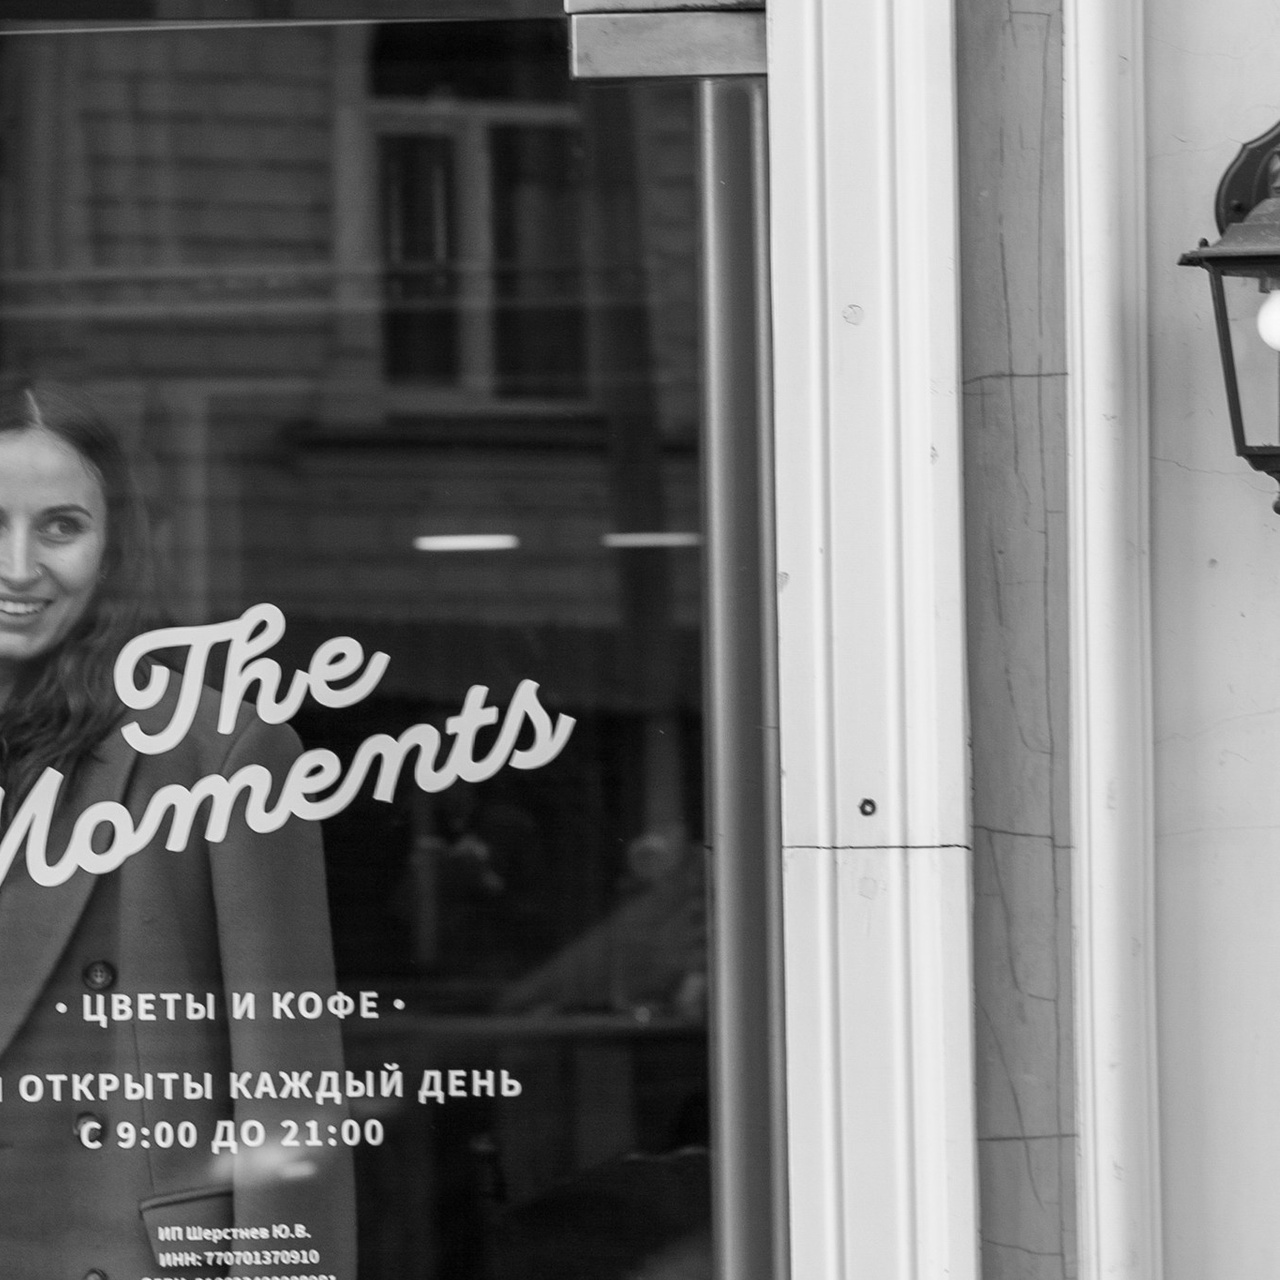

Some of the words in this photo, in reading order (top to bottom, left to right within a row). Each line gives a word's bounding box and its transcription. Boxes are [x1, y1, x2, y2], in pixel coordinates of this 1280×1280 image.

[114, 603, 391, 754] The
[82, 993, 215, 1028] ЦВЕТЫ
[232, 992, 256, 1020] И
[272, 991, 380, 1020] КОФЕ
[18, 1073, 213, 1102] ОТКРЫТЫ
[230, 1063, 403, 1106] КАЖДЫЙ
[418, 1070, 522, 1104] ДЕНЬ
[80, 1121, 102, 1150] С
[116, 1121, 198, 1149] 9:00
[211, 1121, 266, 1154] ДО
[281, 1119, 384, 1147] 21:00
[158, 1226, 183, 1241] ИП
[186, 1226, 269, 1243] Шерстнев
[159, 1252, 202, 1267] ИНН:
[204, 1249, 320, 1266] 770701370910
